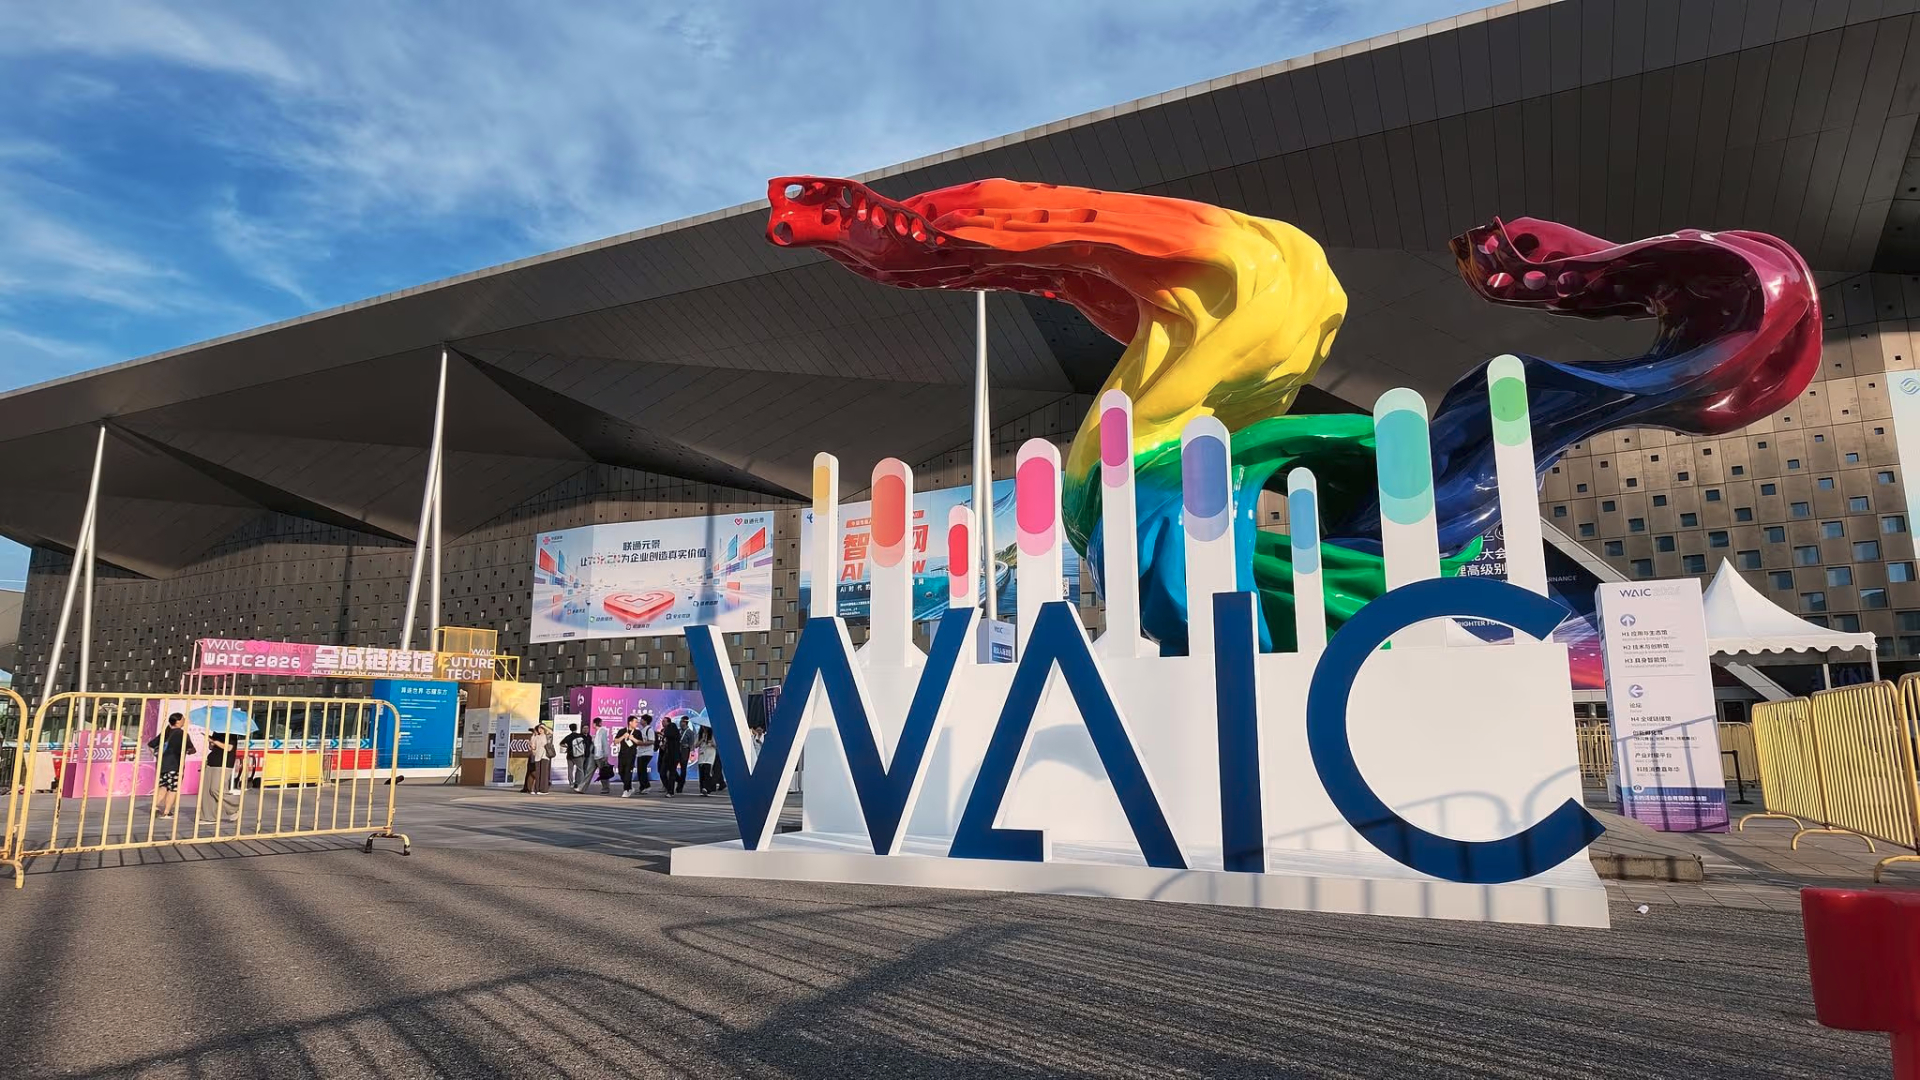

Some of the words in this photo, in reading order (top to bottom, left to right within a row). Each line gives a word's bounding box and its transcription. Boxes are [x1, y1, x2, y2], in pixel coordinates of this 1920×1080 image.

[622, 539, 661, 550] 联通元景
[840, 563, 864, 582] AI
[1620, 588, 1652, 598] WAIC
[207, 639, 245, 651] WAIC
[471, 648, 495, 656] WAIC
[203, 652, 301, 668] WAIC2026
[311, 645, 436, 673] 全域链接馆
[447, 668, 481, 681] TECH
[598, 706, 623, 716] WAIC
[684, 577, 1606, 883] WAIC
[87, 733, 113, 746] H4
